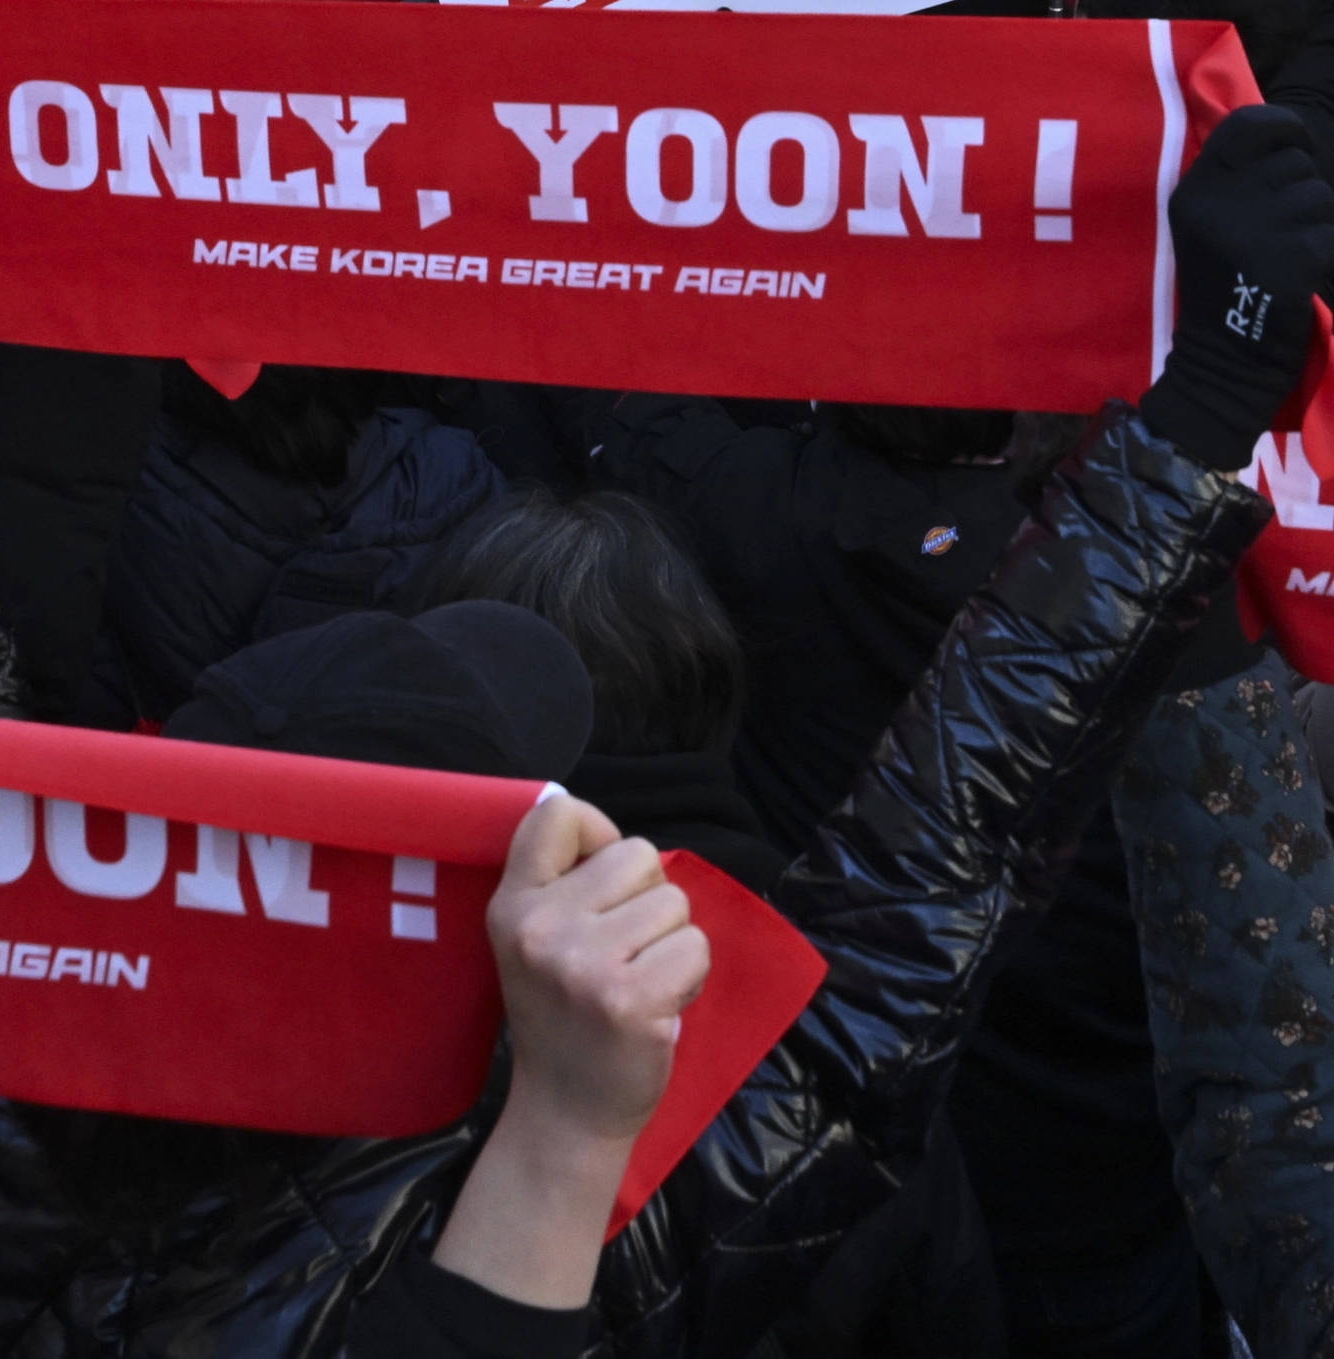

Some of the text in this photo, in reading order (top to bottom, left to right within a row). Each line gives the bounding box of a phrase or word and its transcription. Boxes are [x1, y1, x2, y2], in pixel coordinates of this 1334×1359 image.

[7, 79, 452, 230] ONLY,
[192, 237, 826, 301] MAKE KOREA GREAT AGAIN
